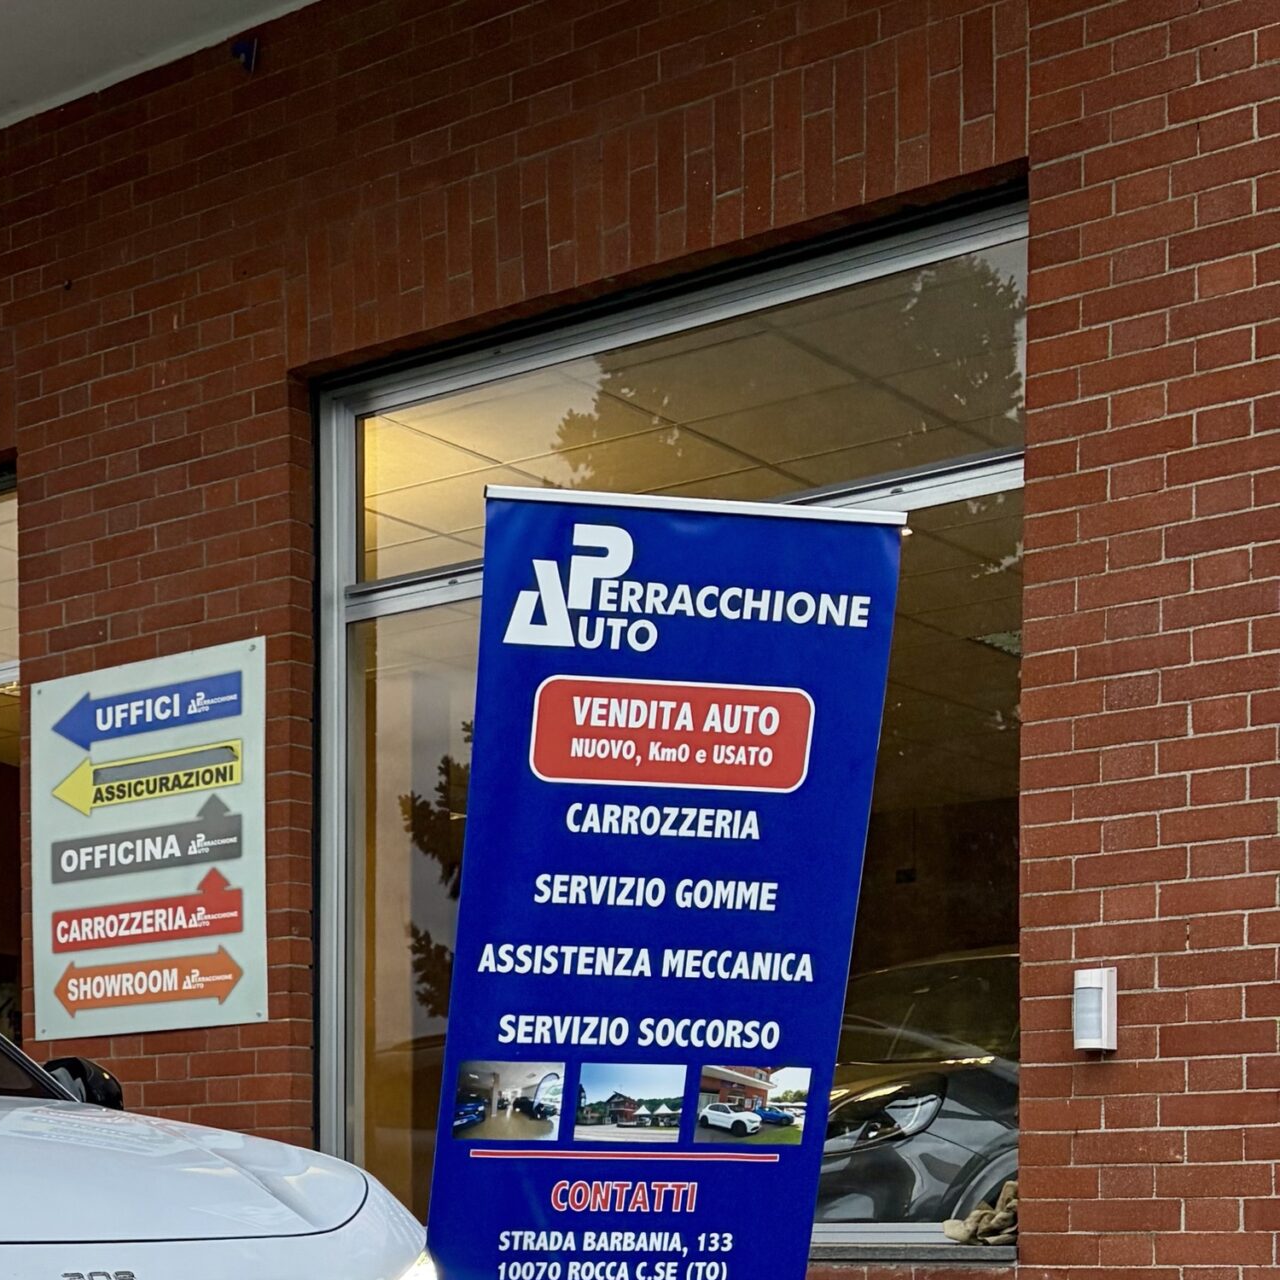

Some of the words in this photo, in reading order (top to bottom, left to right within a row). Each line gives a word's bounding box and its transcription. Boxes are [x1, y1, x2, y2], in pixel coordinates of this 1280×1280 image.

[567, 523, 872, 628] PERRACCHIONE
[502, 559, 658, 652] AUTO
[95, 693, 181, 731] UFFICI
[572, 695, 694, 731] VENDITA
[702, 703, 780, 737] AUTO
[570, 737, 642, 767] NUOVO,
[648, 741, 690, 763] Km0
[695, 747, 706, 764] e
[712, 744, 773, 767] USATO
[92, 764, 235, 804] ASSICURAZIONI
[565, 802, 760, 840] CARROZZERIA
[60, 835, 181, 873] OFFICINA
[533, 873, 666, 908] SERVIZIO
[675, 878, 778, 911] GOMME
[56, 906, 188, 944] CARROZZERIA
[477, 943, 652, 977] ASSISTENZA
[661, 948, 814, 983] MECCANICA
[67, 968, 179, 1001] SHOWROOM
[497, 1013, 630, 1047] SERVIZIO
[637, 1017, 781, 1050] SOCCORSO
[551, 1180, 698, 1213] CONTATTI
[498, 1231, 576, 1252] STRADA
[582, 1232, 688, 1258] BARBANIA,
[696, 1233, 733, 1252] 133
[497, 1262, 561, 1280] 10070
